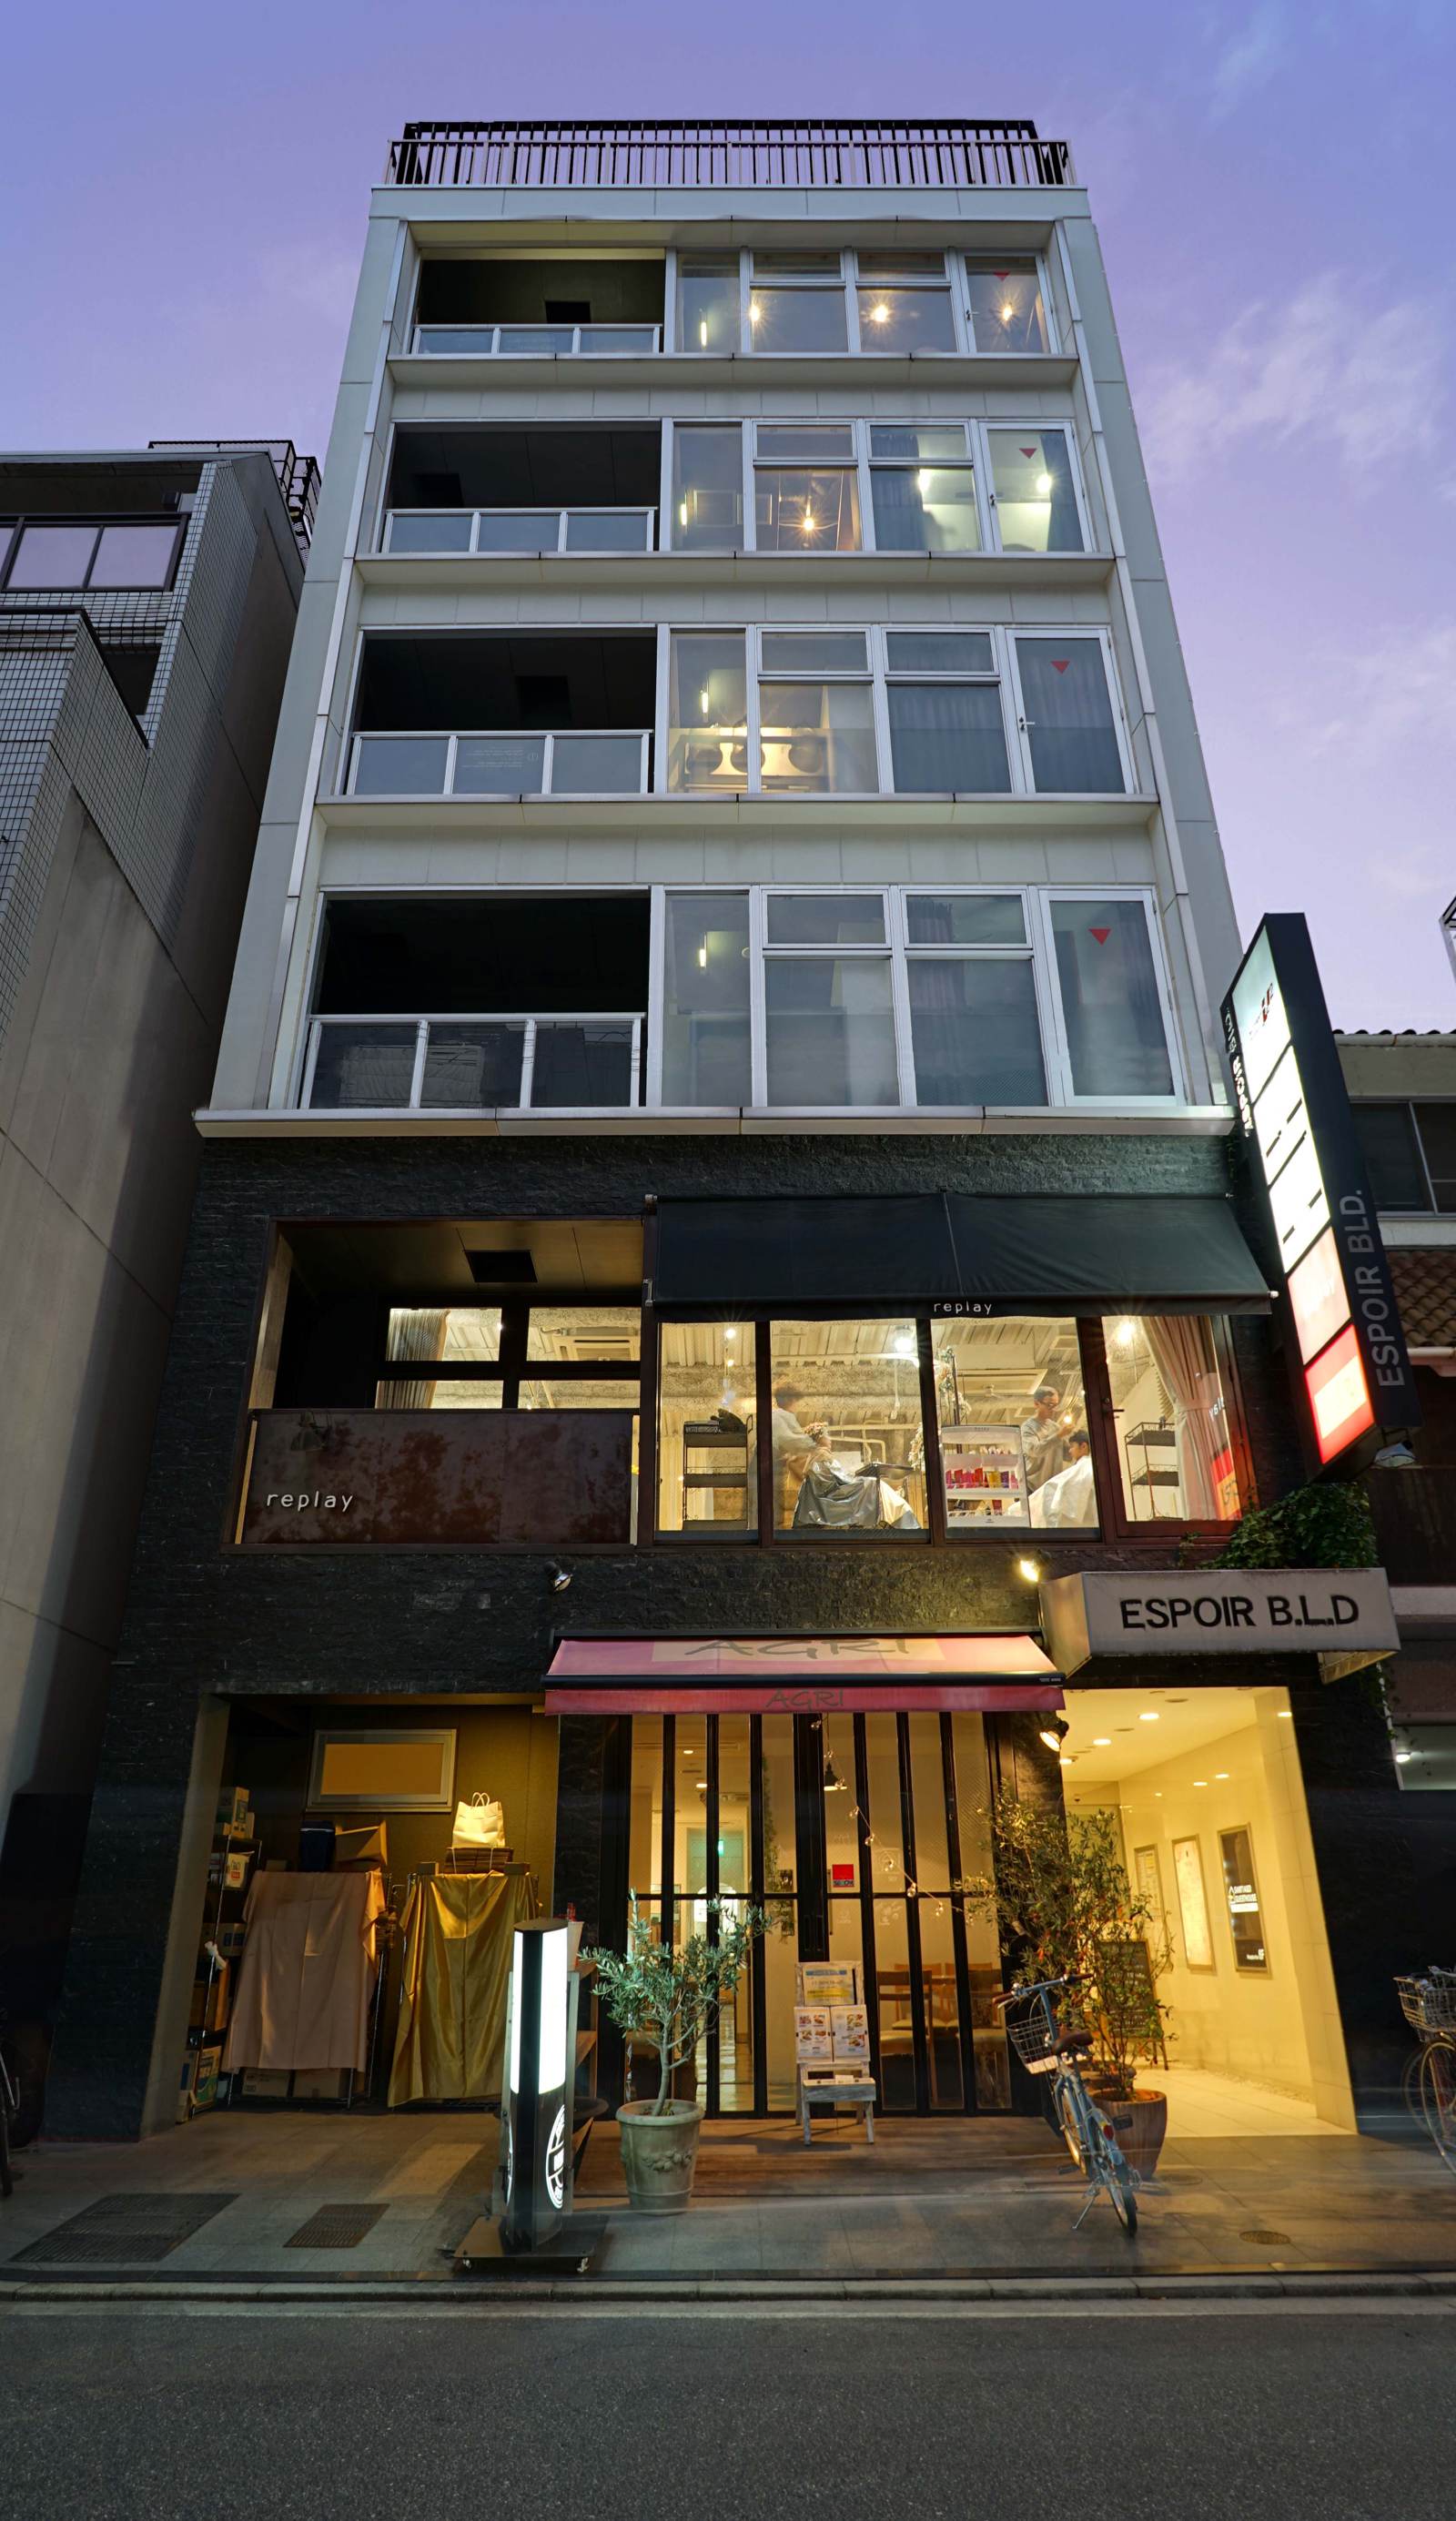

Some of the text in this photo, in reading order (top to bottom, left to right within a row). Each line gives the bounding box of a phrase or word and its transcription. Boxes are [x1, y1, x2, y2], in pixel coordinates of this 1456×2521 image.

[1339, 1190, 1405, 1386] ESPOIR BLD.
[934, 1300, 992, 1315] replay
[267, 1490, 353, 1513] replay
[1119, 1595, 1360, 1629] ESPOIR B.L.D
[684, 1638, 910, 1660] AGRI
[764, 1688, 844, 1711] AGRI
